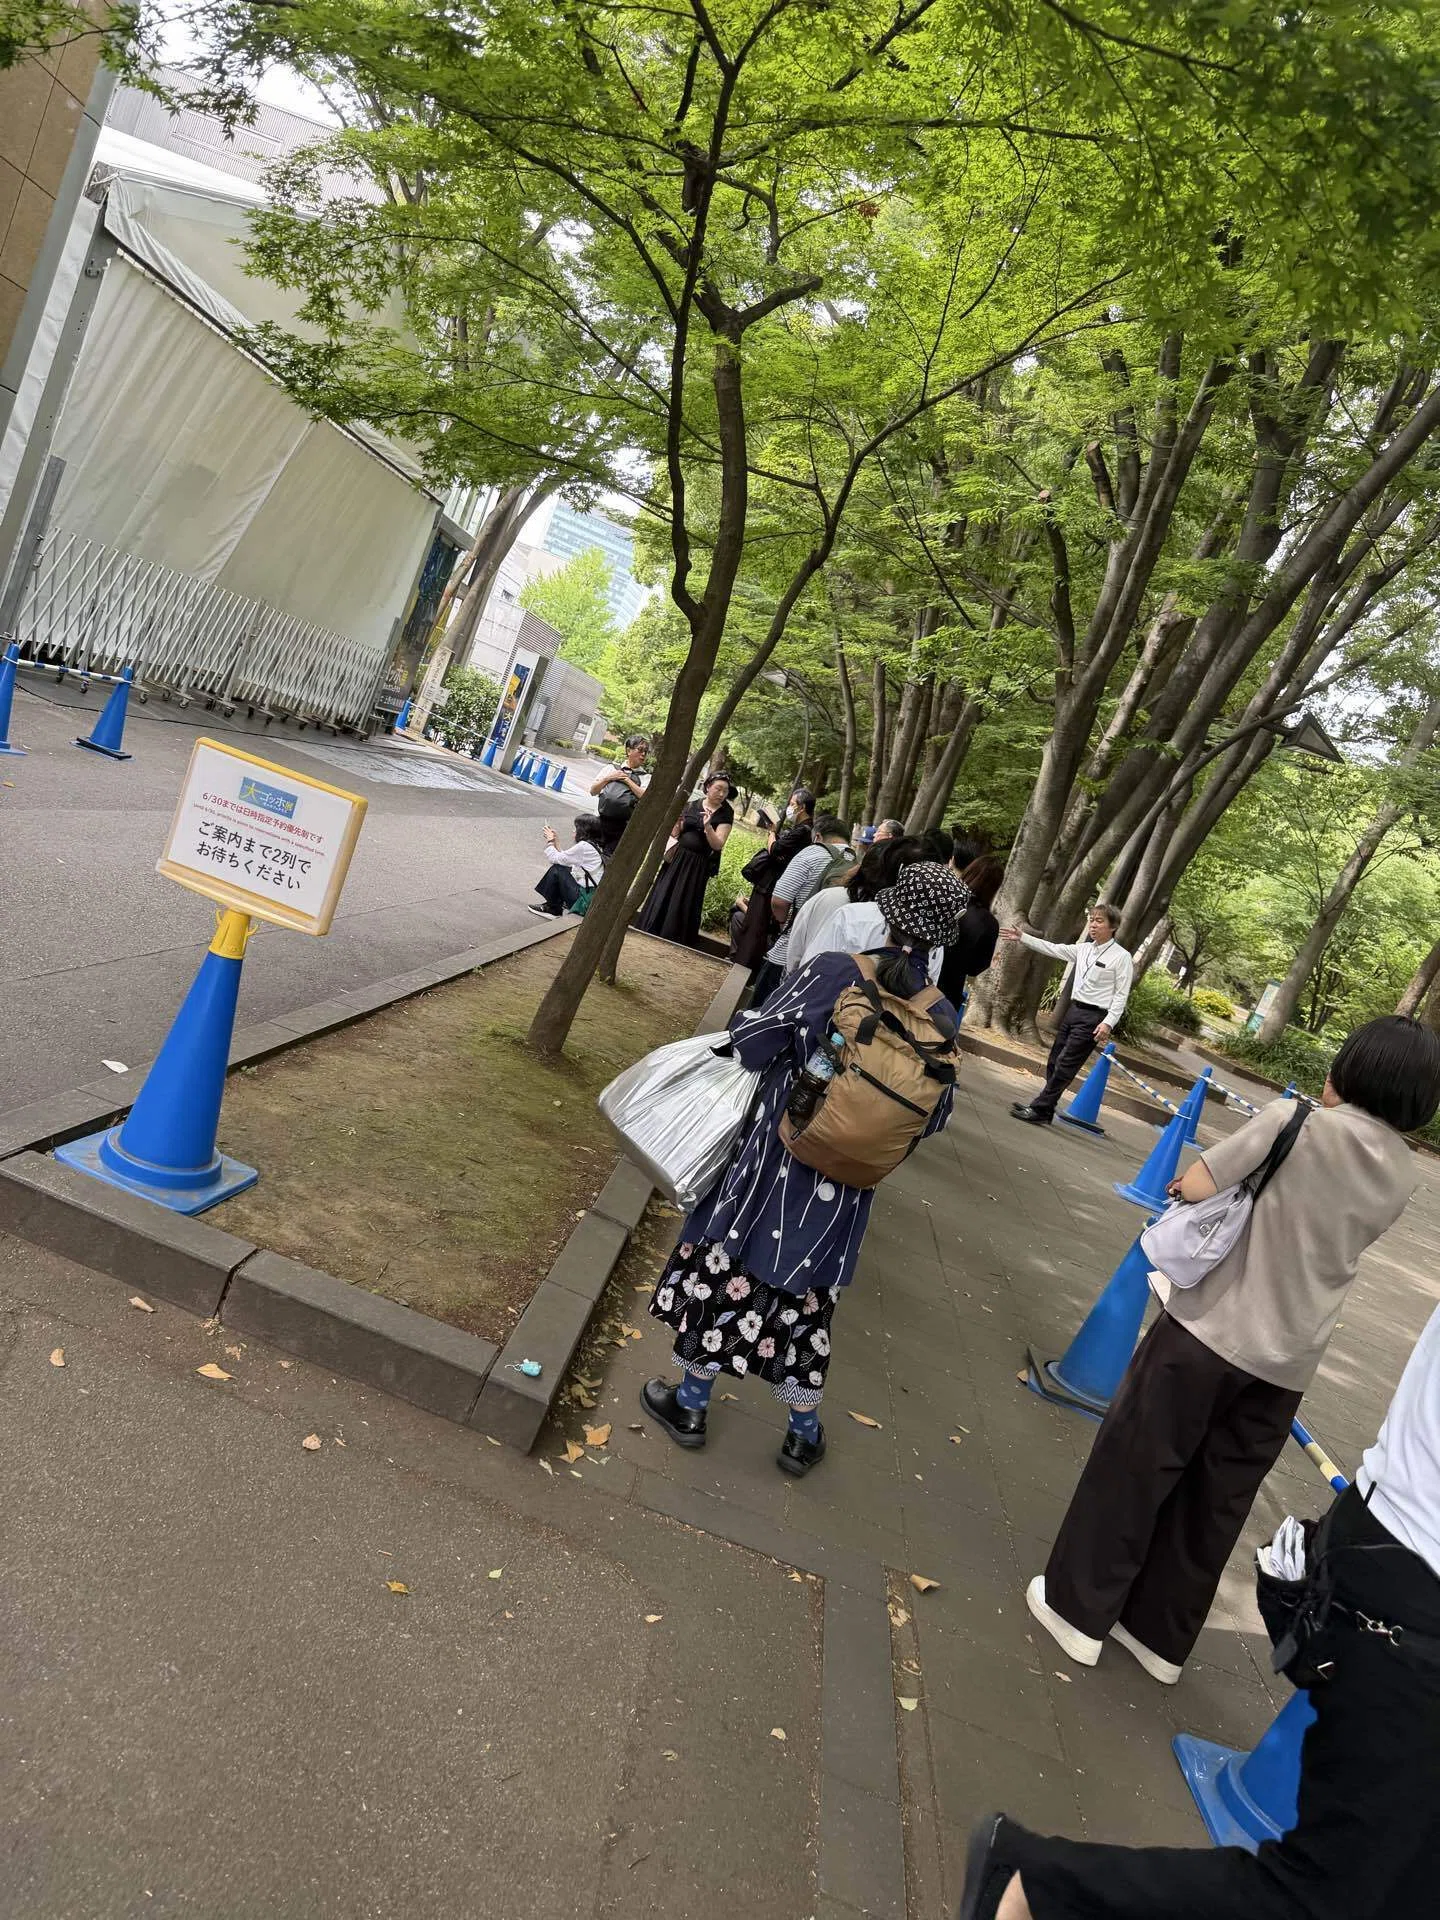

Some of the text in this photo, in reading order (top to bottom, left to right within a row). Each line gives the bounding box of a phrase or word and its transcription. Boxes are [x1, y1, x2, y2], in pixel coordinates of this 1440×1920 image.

[196, 841, 300, 889] お待ちください
[198, 821, 311, 874] ご案内まで2列で
